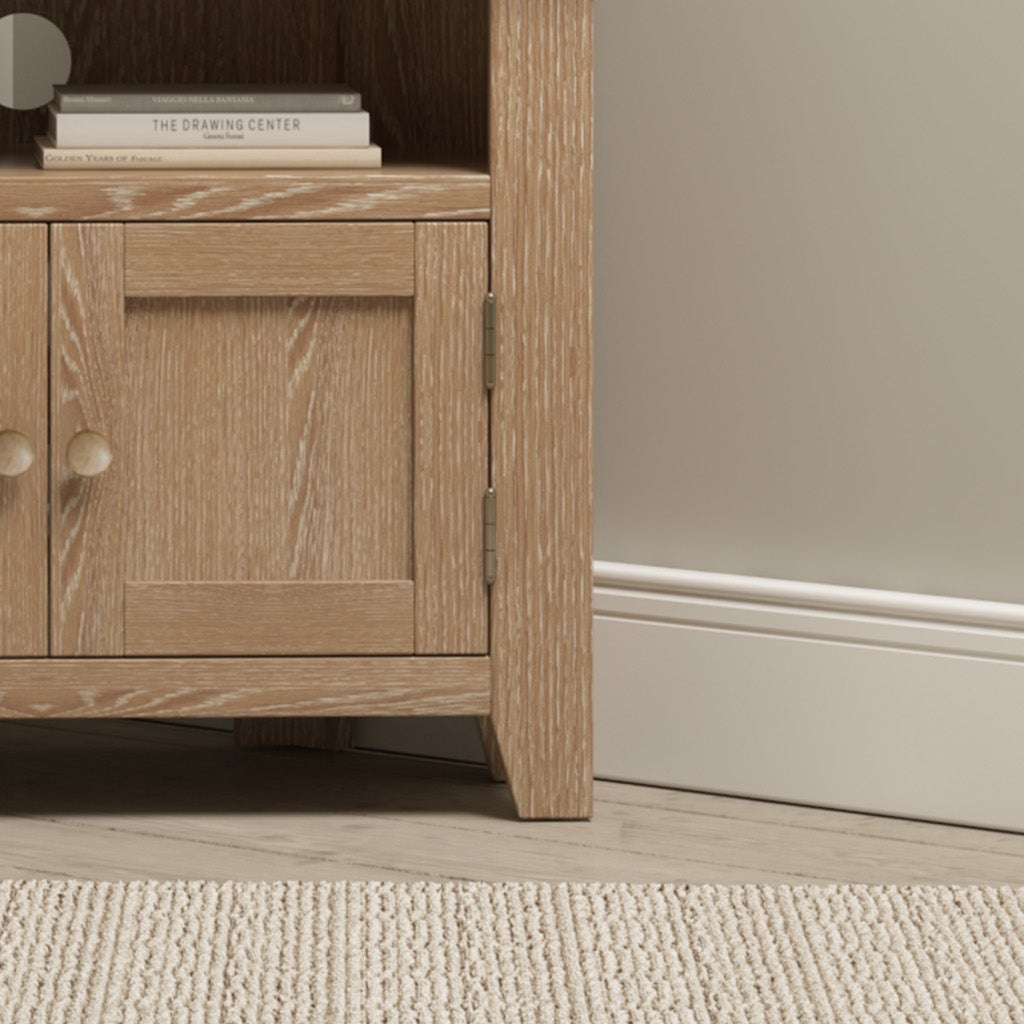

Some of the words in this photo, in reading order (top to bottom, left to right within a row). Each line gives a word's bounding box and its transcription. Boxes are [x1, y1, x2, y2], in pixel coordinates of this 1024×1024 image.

[152, 119, 178, 132] THE
[182, 118, 244, 132] DRAWING
[248, 118, 301, 131] CENTER
[45, 154, 83, 163] GOLDEN
[85, 154, 114, 163] YEARS
